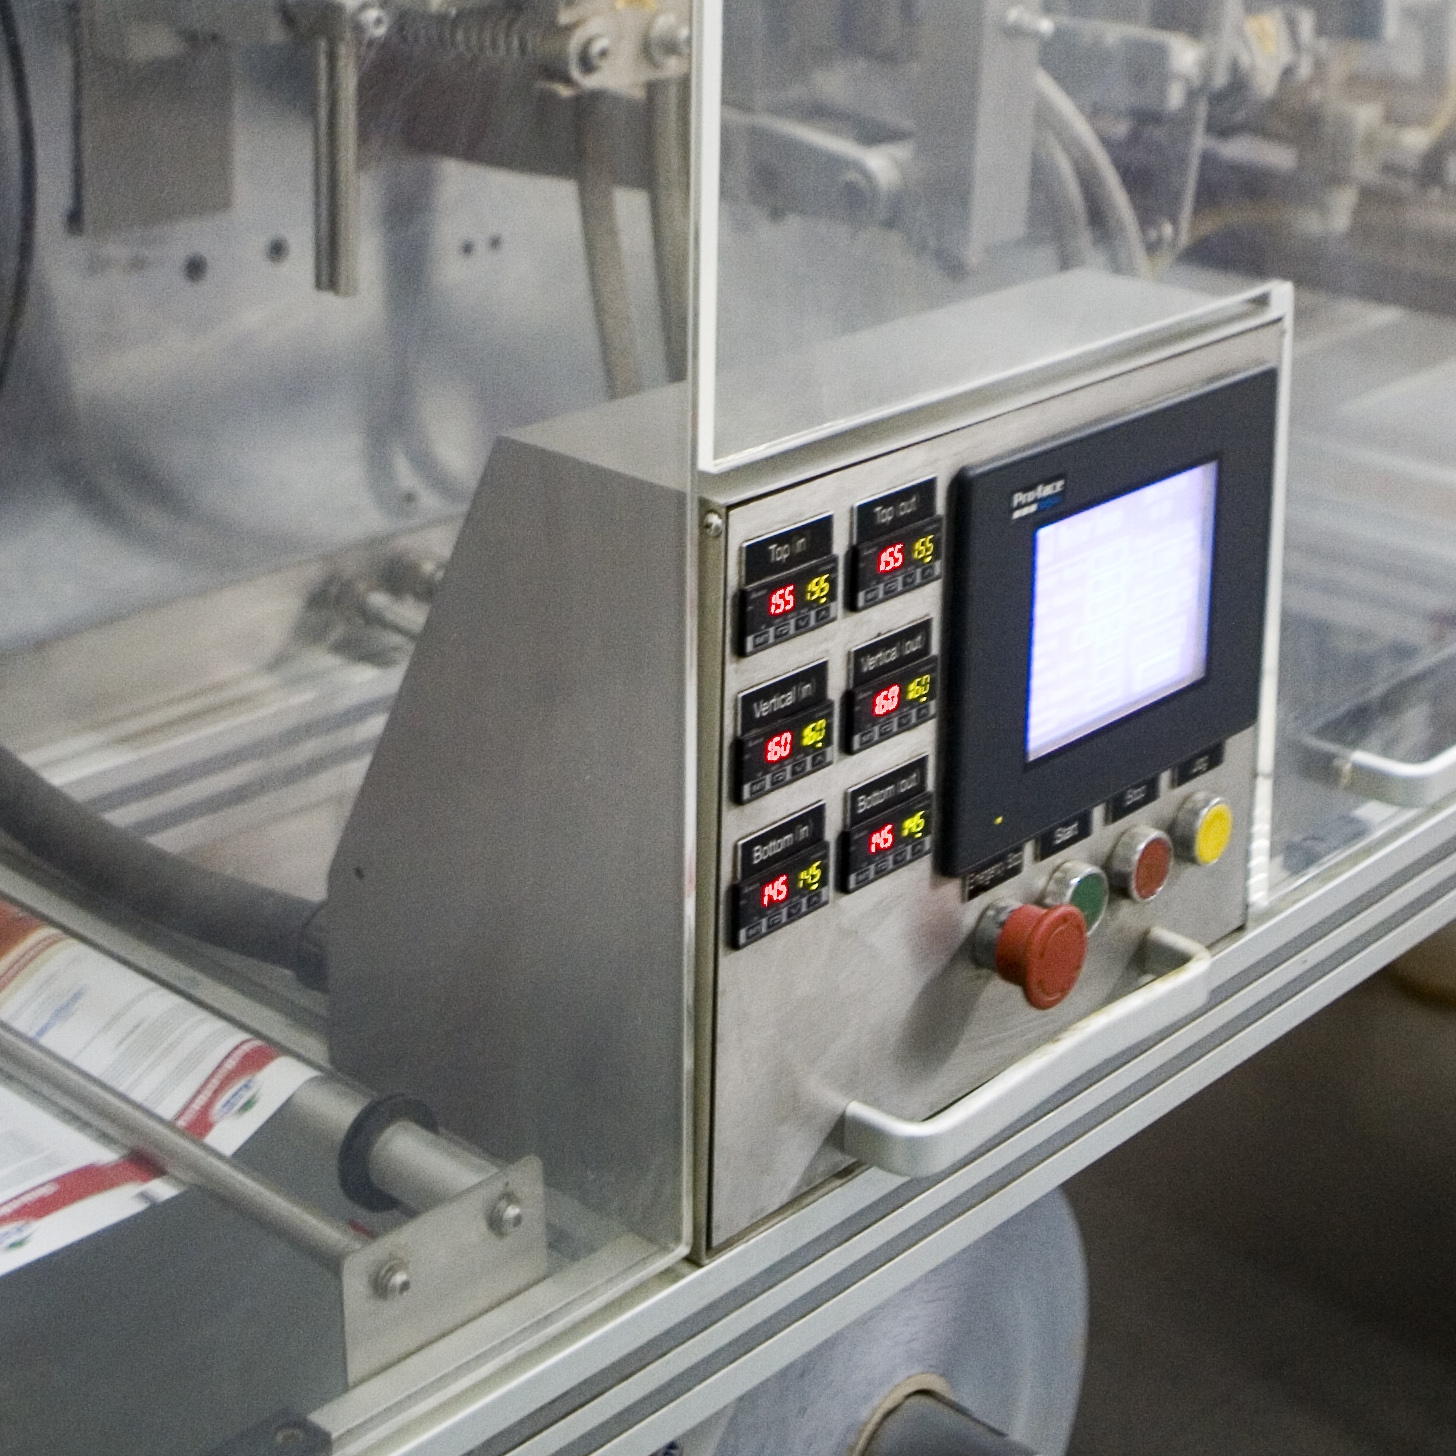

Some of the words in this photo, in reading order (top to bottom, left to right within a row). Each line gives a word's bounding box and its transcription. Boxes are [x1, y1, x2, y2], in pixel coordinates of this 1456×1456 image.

[873, 505, 895, 527] Top
[768, 543, 791, 564] Top
[877, 542, 904, 574] 155
[769, 584, 795, 616] 155
[860, 641, 898, 673] Vertical
[753, 685, 796, 719] Vertical
[765, 731, 792, 763] 160
[857, 784, 895, 814] Bottom
[752, 833, 794, 865] Bottom
[869, 824, 893, 854] 145
[761, 874, 789, 907] 145
